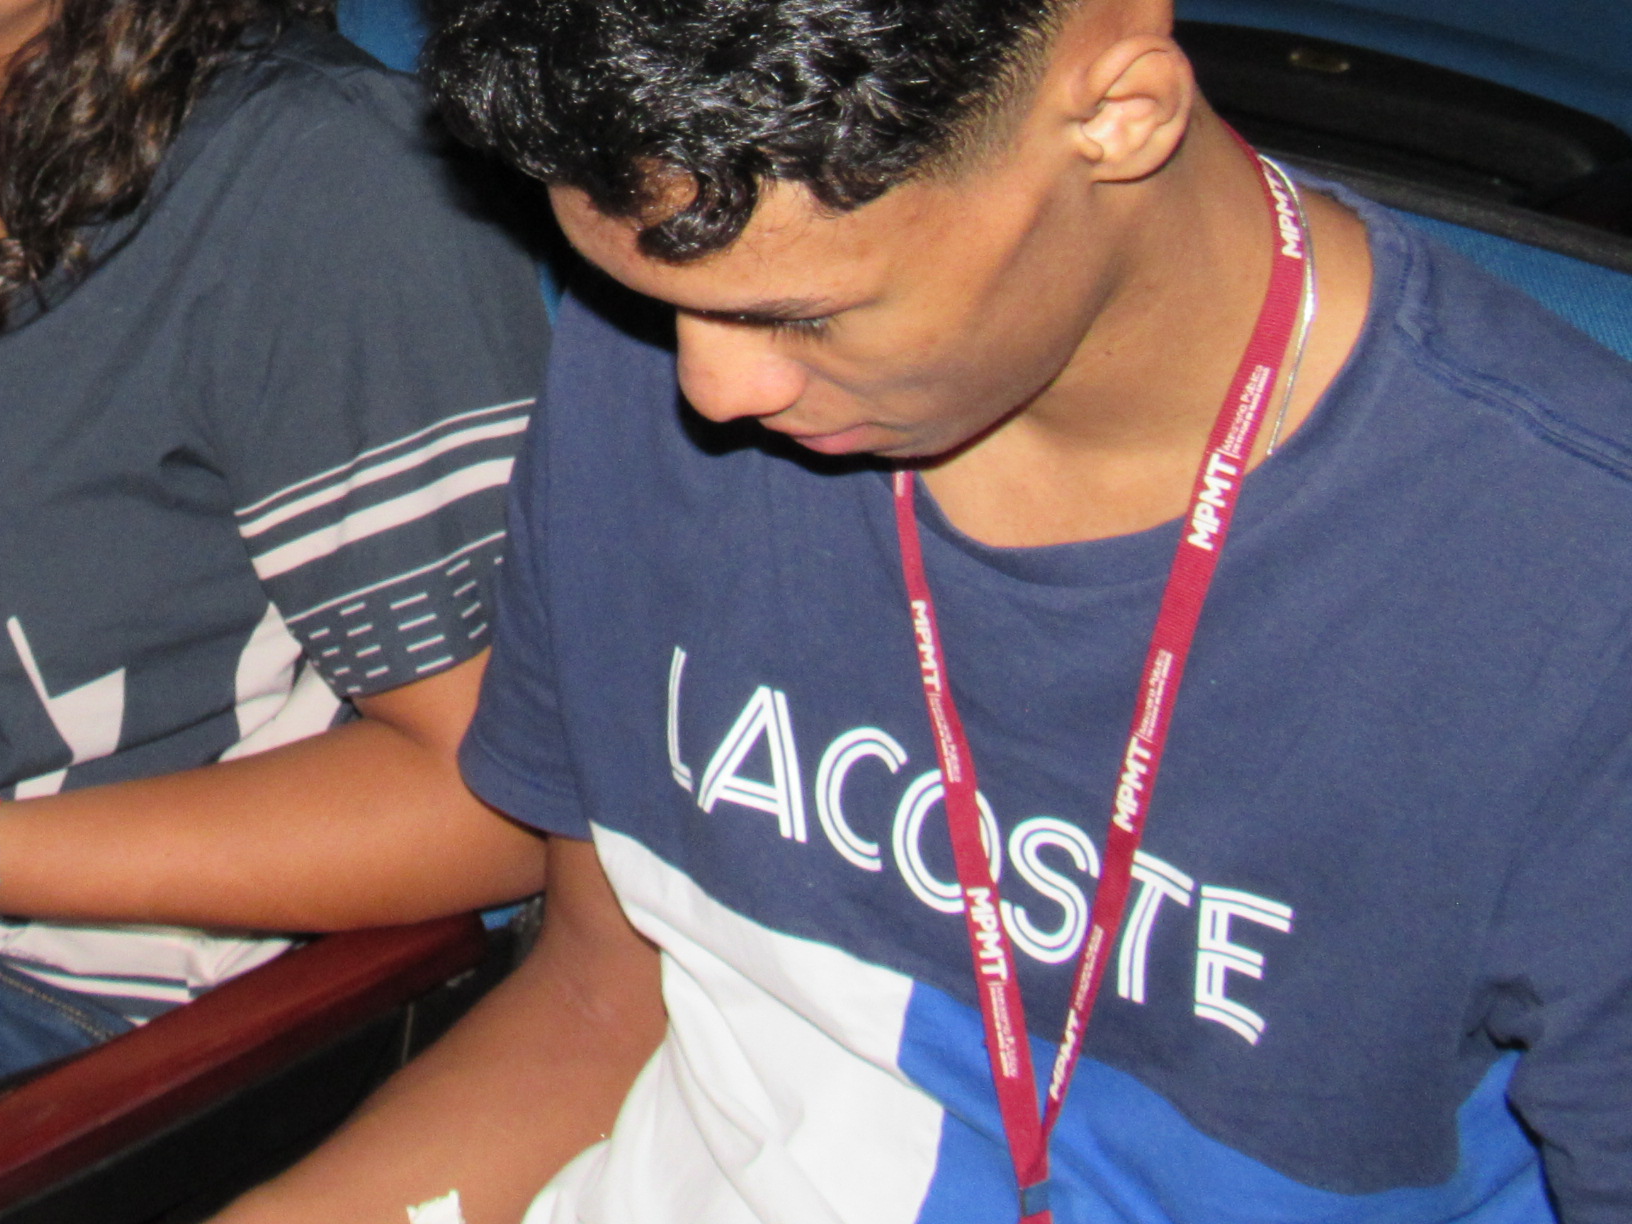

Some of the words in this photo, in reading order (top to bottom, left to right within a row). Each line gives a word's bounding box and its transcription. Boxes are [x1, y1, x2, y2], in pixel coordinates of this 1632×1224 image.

[1263, 169, 1303, 259] MPMT
[1187, 453, 1239, 551] MPMT
[911, 599, 941, 693] MPMT
[1112, 736, 1152, 832] MPMT
[668, 645, 1294, 1045] LACOSTE
[966, 886, 1009, 981] MPMT
